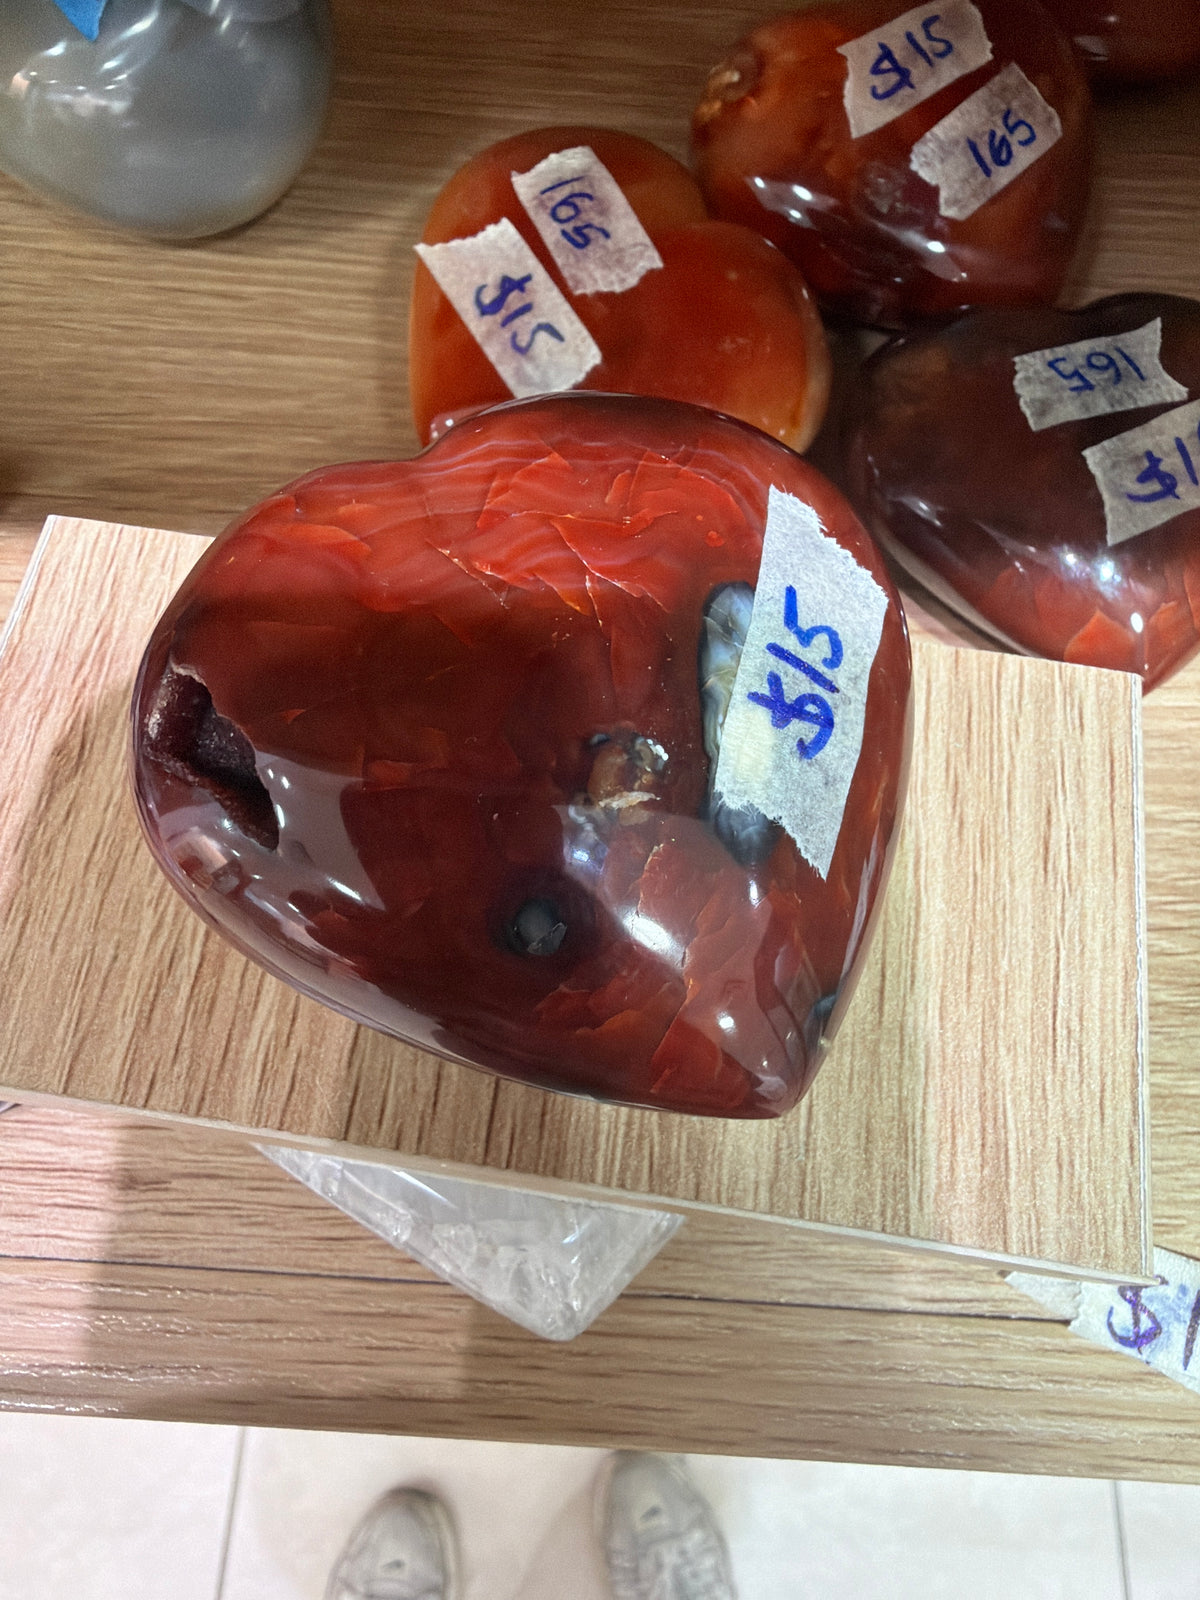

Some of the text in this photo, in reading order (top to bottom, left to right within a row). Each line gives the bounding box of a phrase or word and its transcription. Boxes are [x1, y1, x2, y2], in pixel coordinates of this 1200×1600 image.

[869, 14, 953, 100] $15
[966, 108, 1036, 178] 165
[540, 175, 611, 250] 165
[474, 273, 565, 355] $15
[1047, 347, 1146, 392] 165
[1126, 420, 1200, 503] $1
[747, 584, 844, 760] $15
